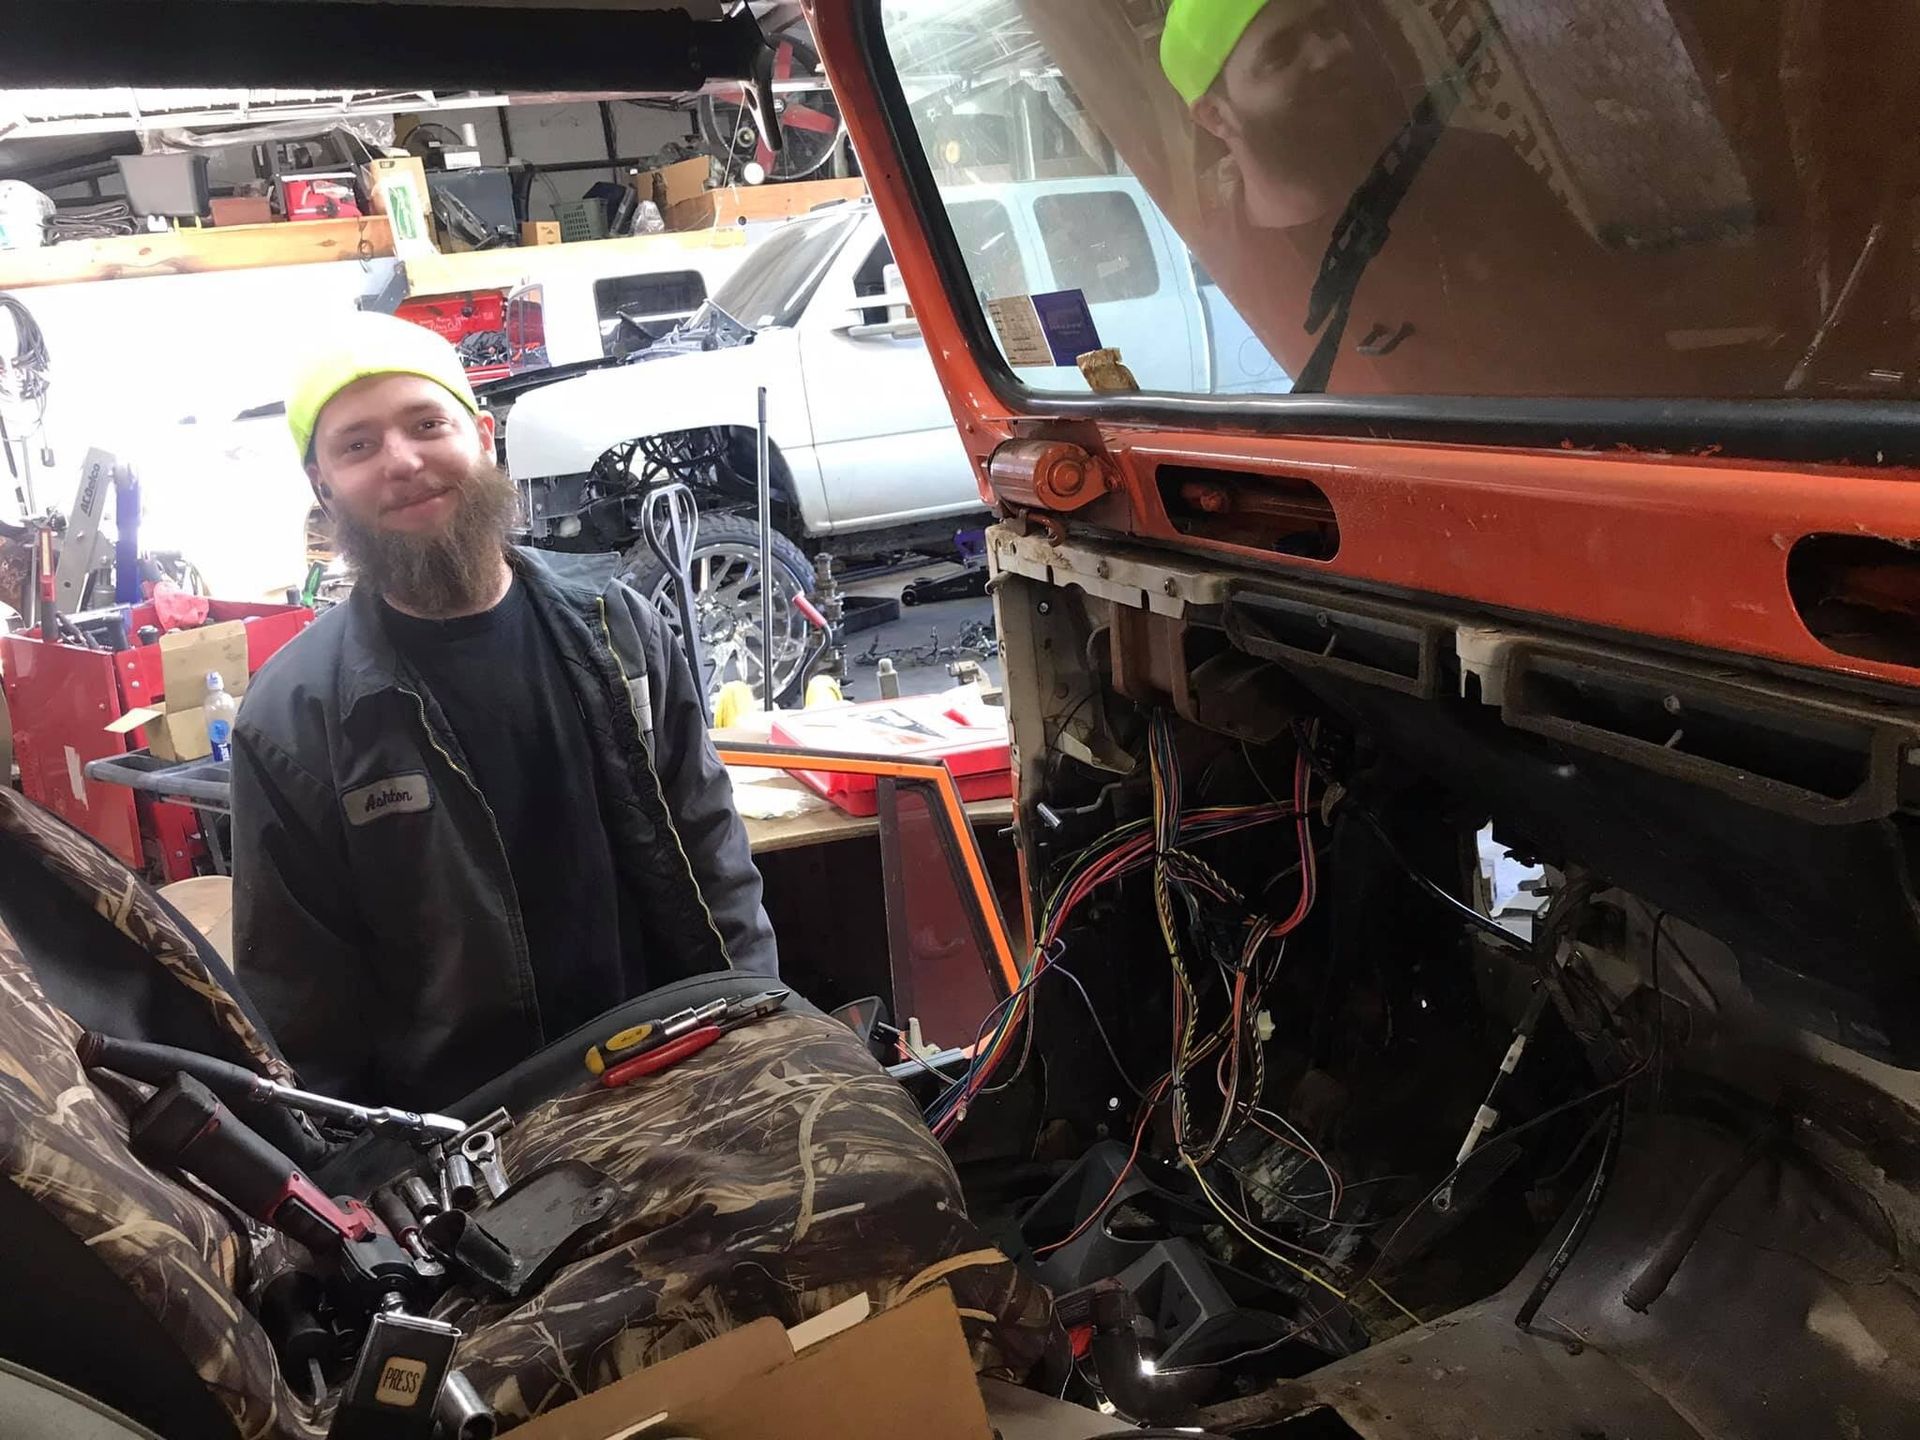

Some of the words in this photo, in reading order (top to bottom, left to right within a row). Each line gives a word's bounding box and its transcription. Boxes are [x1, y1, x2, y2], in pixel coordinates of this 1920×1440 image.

[80, 463, 100, 515] ACDelco
[365, 789, 413, 812] Ashton
[382, 1367, 420, 1393] PRESS
